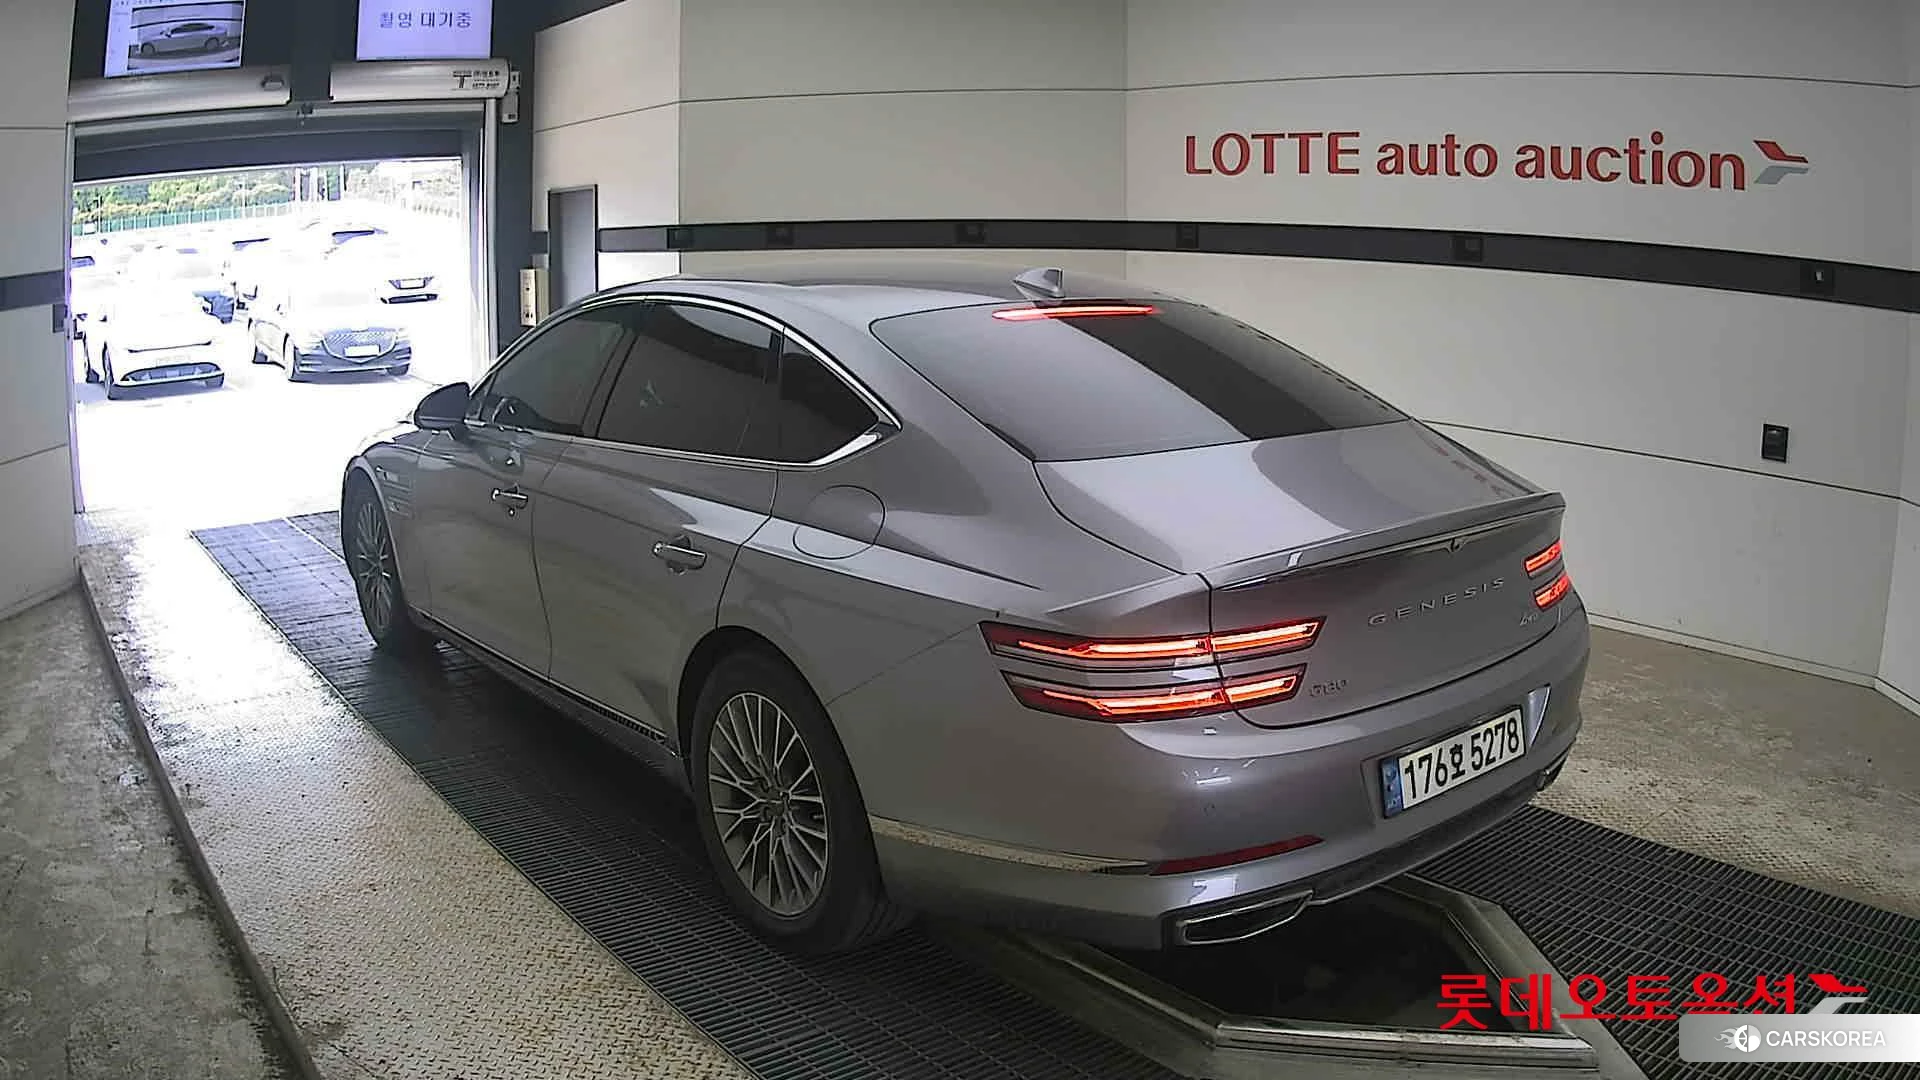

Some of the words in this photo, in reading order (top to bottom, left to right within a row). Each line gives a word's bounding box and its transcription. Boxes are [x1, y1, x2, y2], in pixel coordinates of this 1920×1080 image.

[421, 11, 472, 29] 대기중
[1185, 131, 1361, 176] LOTTE
[1376, 133, 1499, 178] auto
[1514, 131, 1746, 191] auction
[1368, 577, 1505, 626] GENESIS
[1404, 743, 1466, 799] 176호
[1470, 717, 1520, 771] 5278
